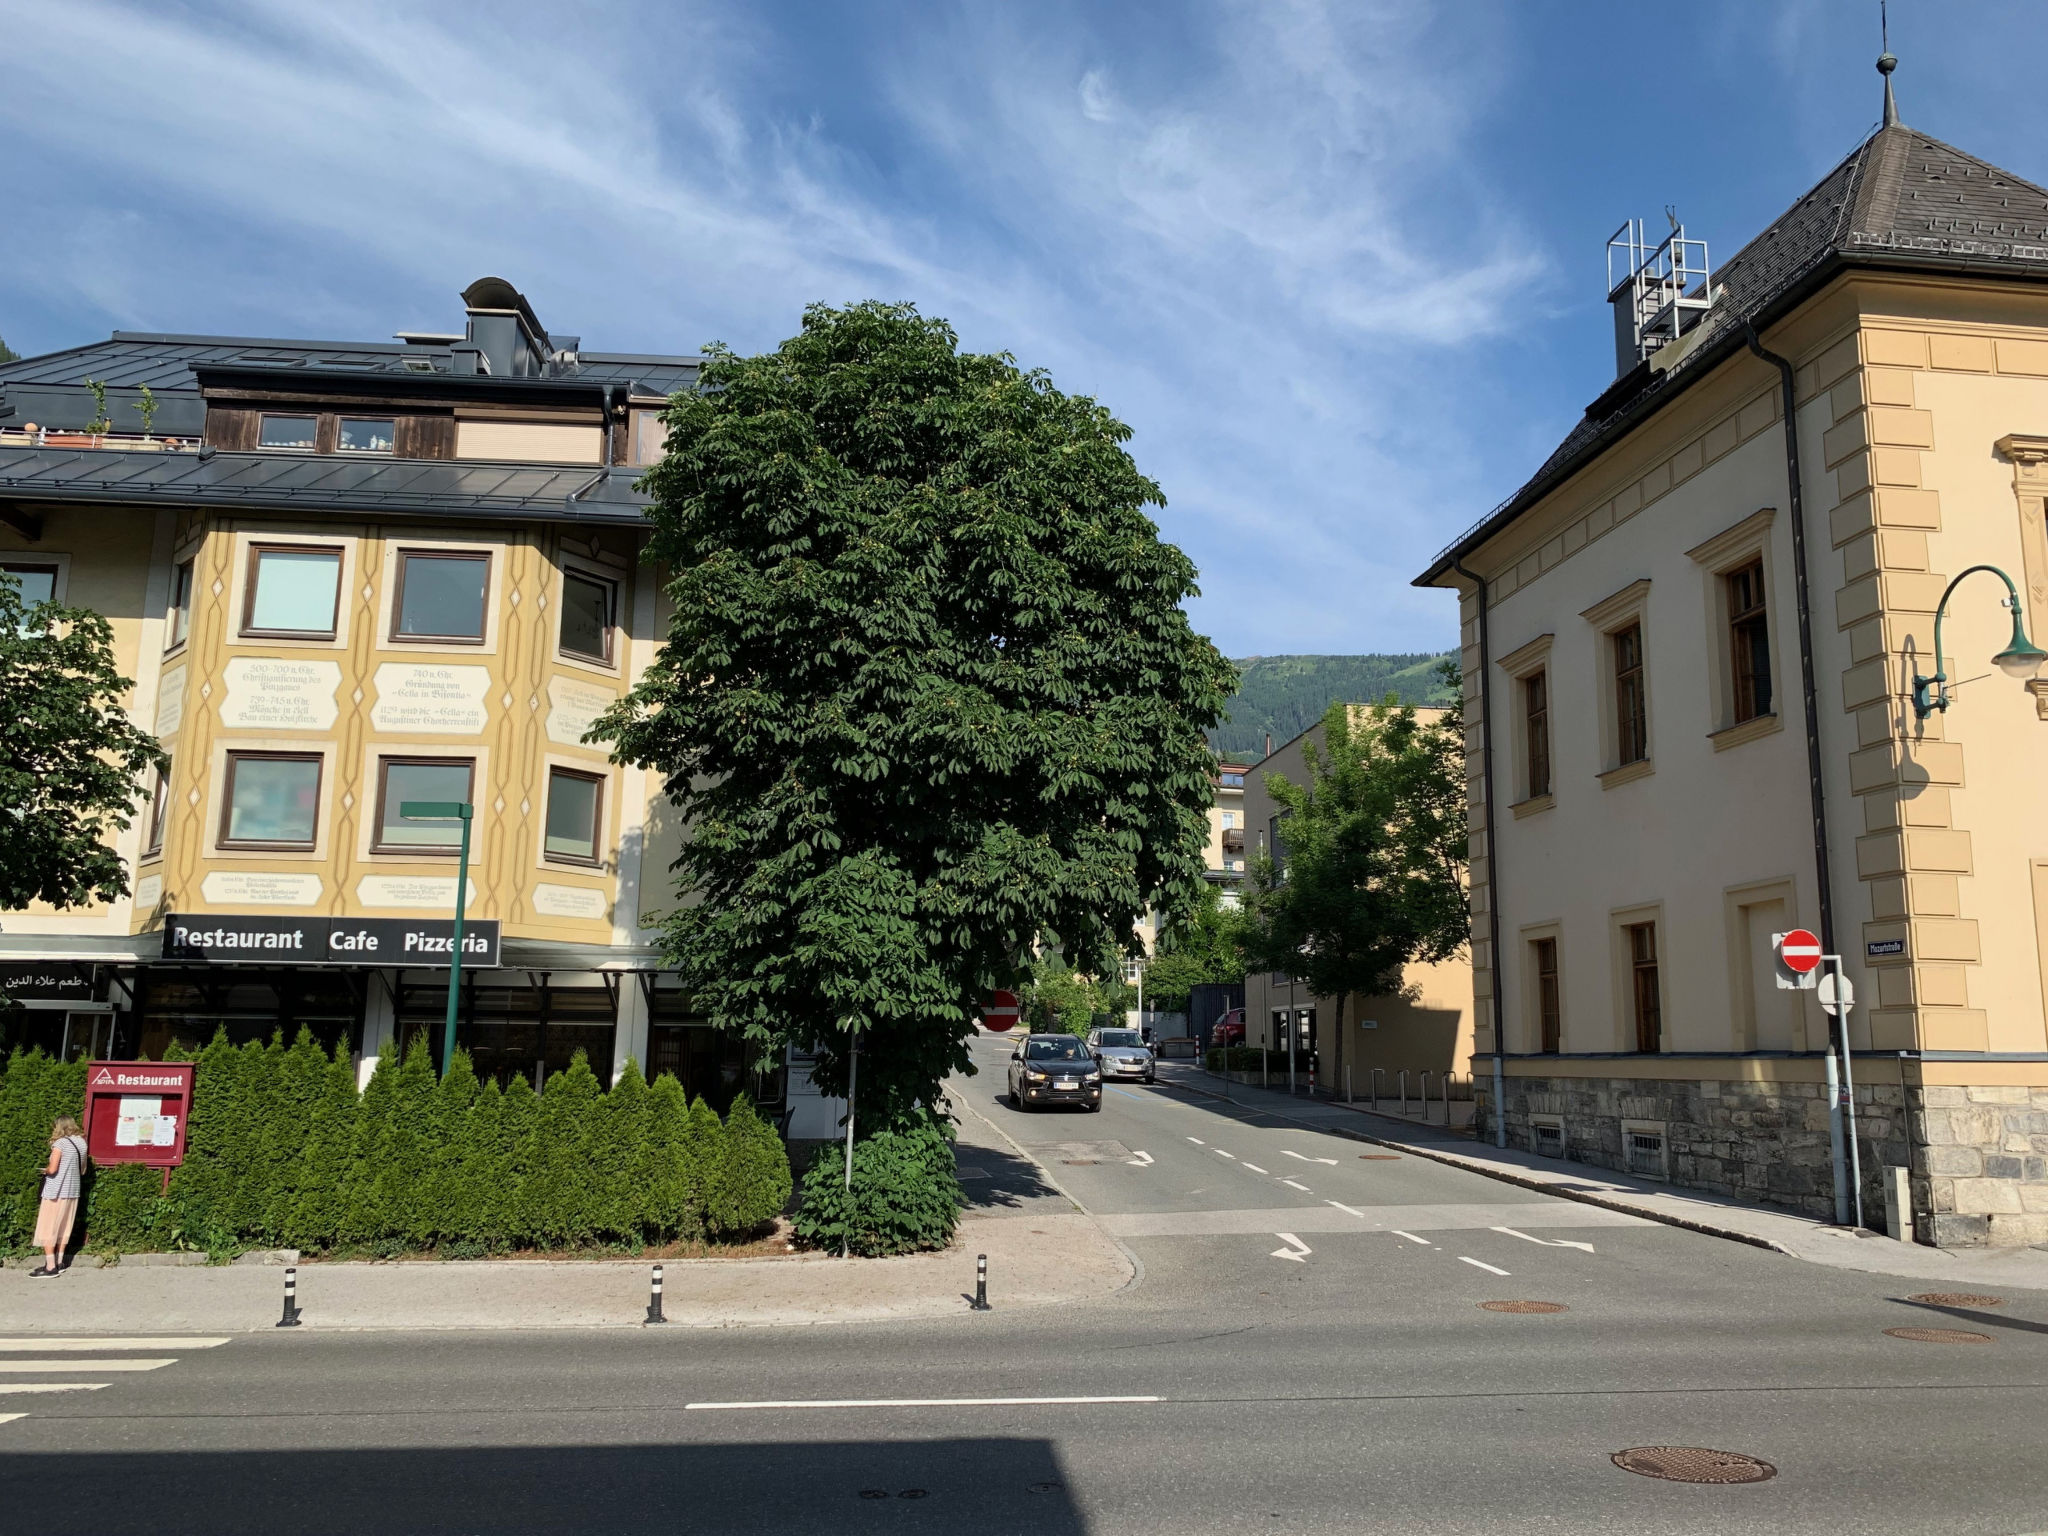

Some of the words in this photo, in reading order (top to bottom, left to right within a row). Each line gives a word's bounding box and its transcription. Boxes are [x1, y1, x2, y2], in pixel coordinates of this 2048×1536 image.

[405, 679, 445, 689] Gründung
[173, 927, 303, 948] Restaurant
[329, 931, 379, 950] Cafe
[404, 932, 488, 953] Pizzeria
[1870, 942, 1901, 954] Mozartstraße
[6, 975, 32, 988] الدين
[35, 975, 56, 986] علاء
[118, 1074, 182, 1086] Restaurant
